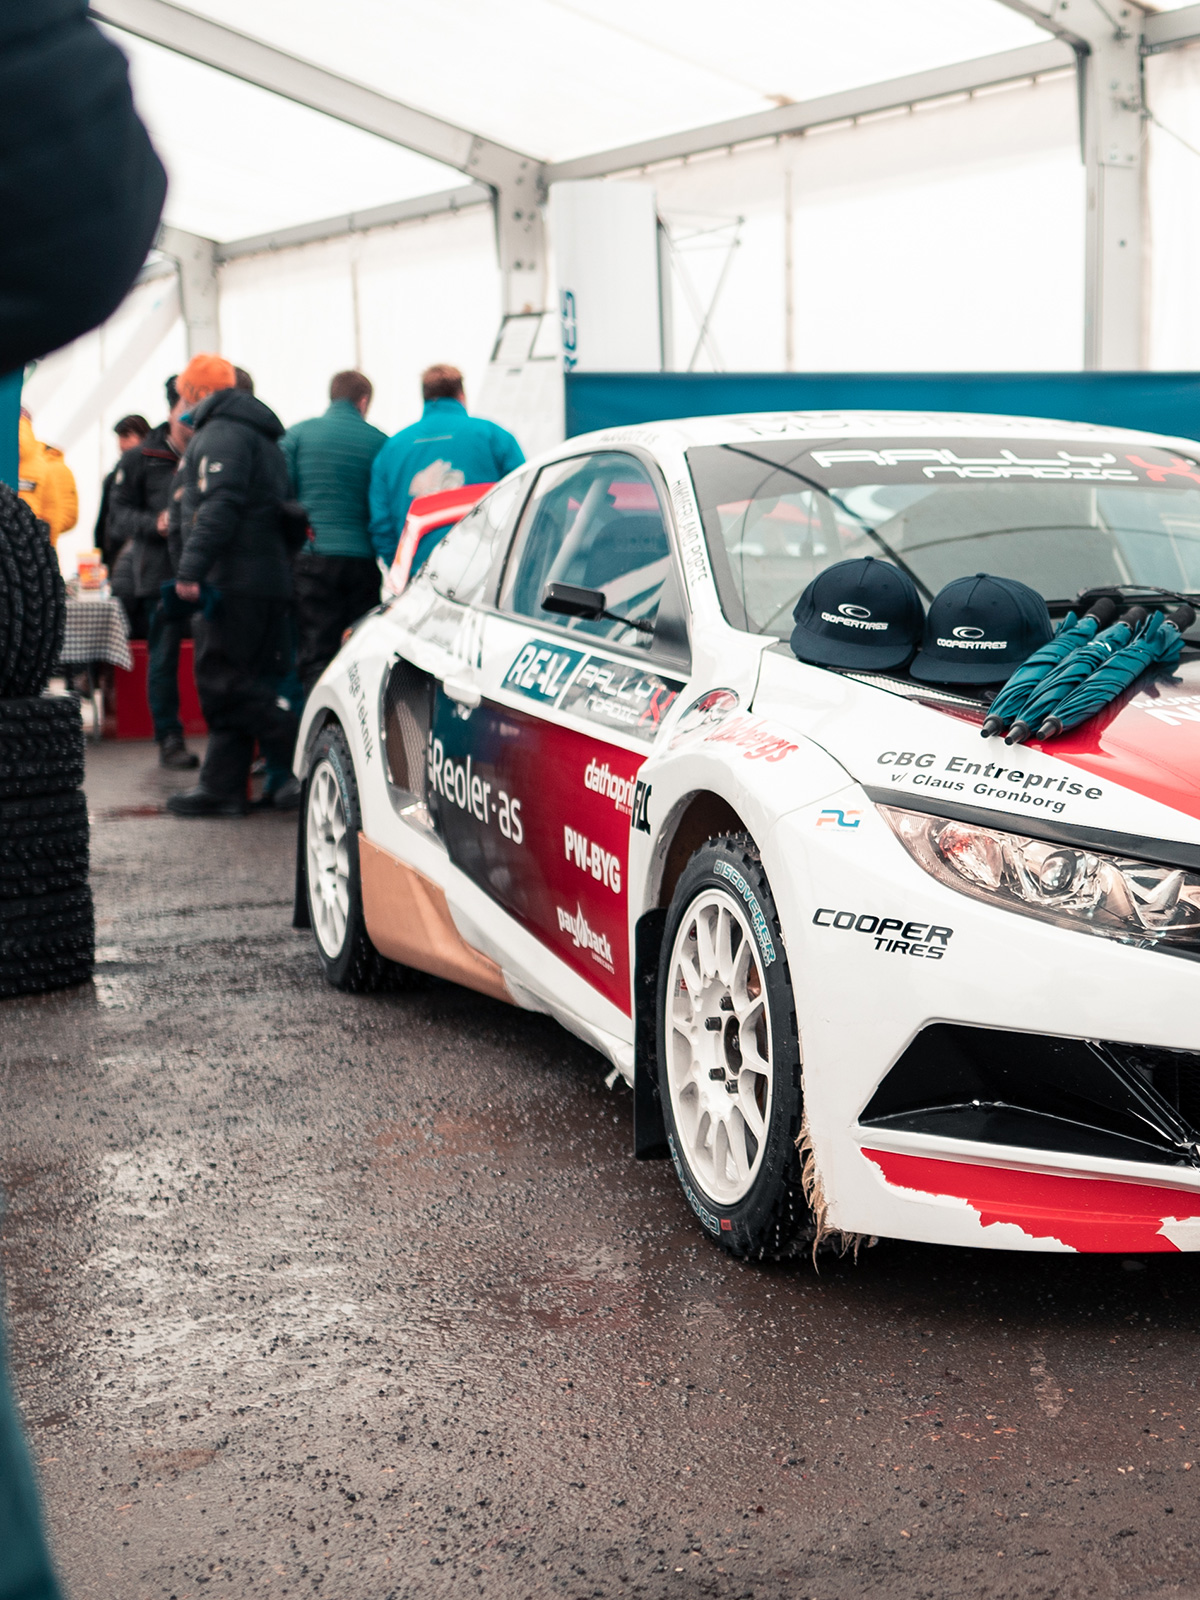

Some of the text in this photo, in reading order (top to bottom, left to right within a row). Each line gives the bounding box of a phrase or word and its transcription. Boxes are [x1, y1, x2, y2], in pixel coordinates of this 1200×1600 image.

[922, 466, 1139, 481] NORDIC
[507, 645, 571, 698] REAL
[356, 691, 373, 764] Teknik
[584, 695, 640, 725] NORDIC
[876, 751, 1103, 800] CBG Entreprise
[890, 772, 1066, 814] v/ Claus Grønborg
[564, 825, 622, 894] PW-BYG
[713, 860, 776, 962] DISCOVERER
[812, 908, 954, 945] COOPER
[874, 937, 946, 960] TIRES
